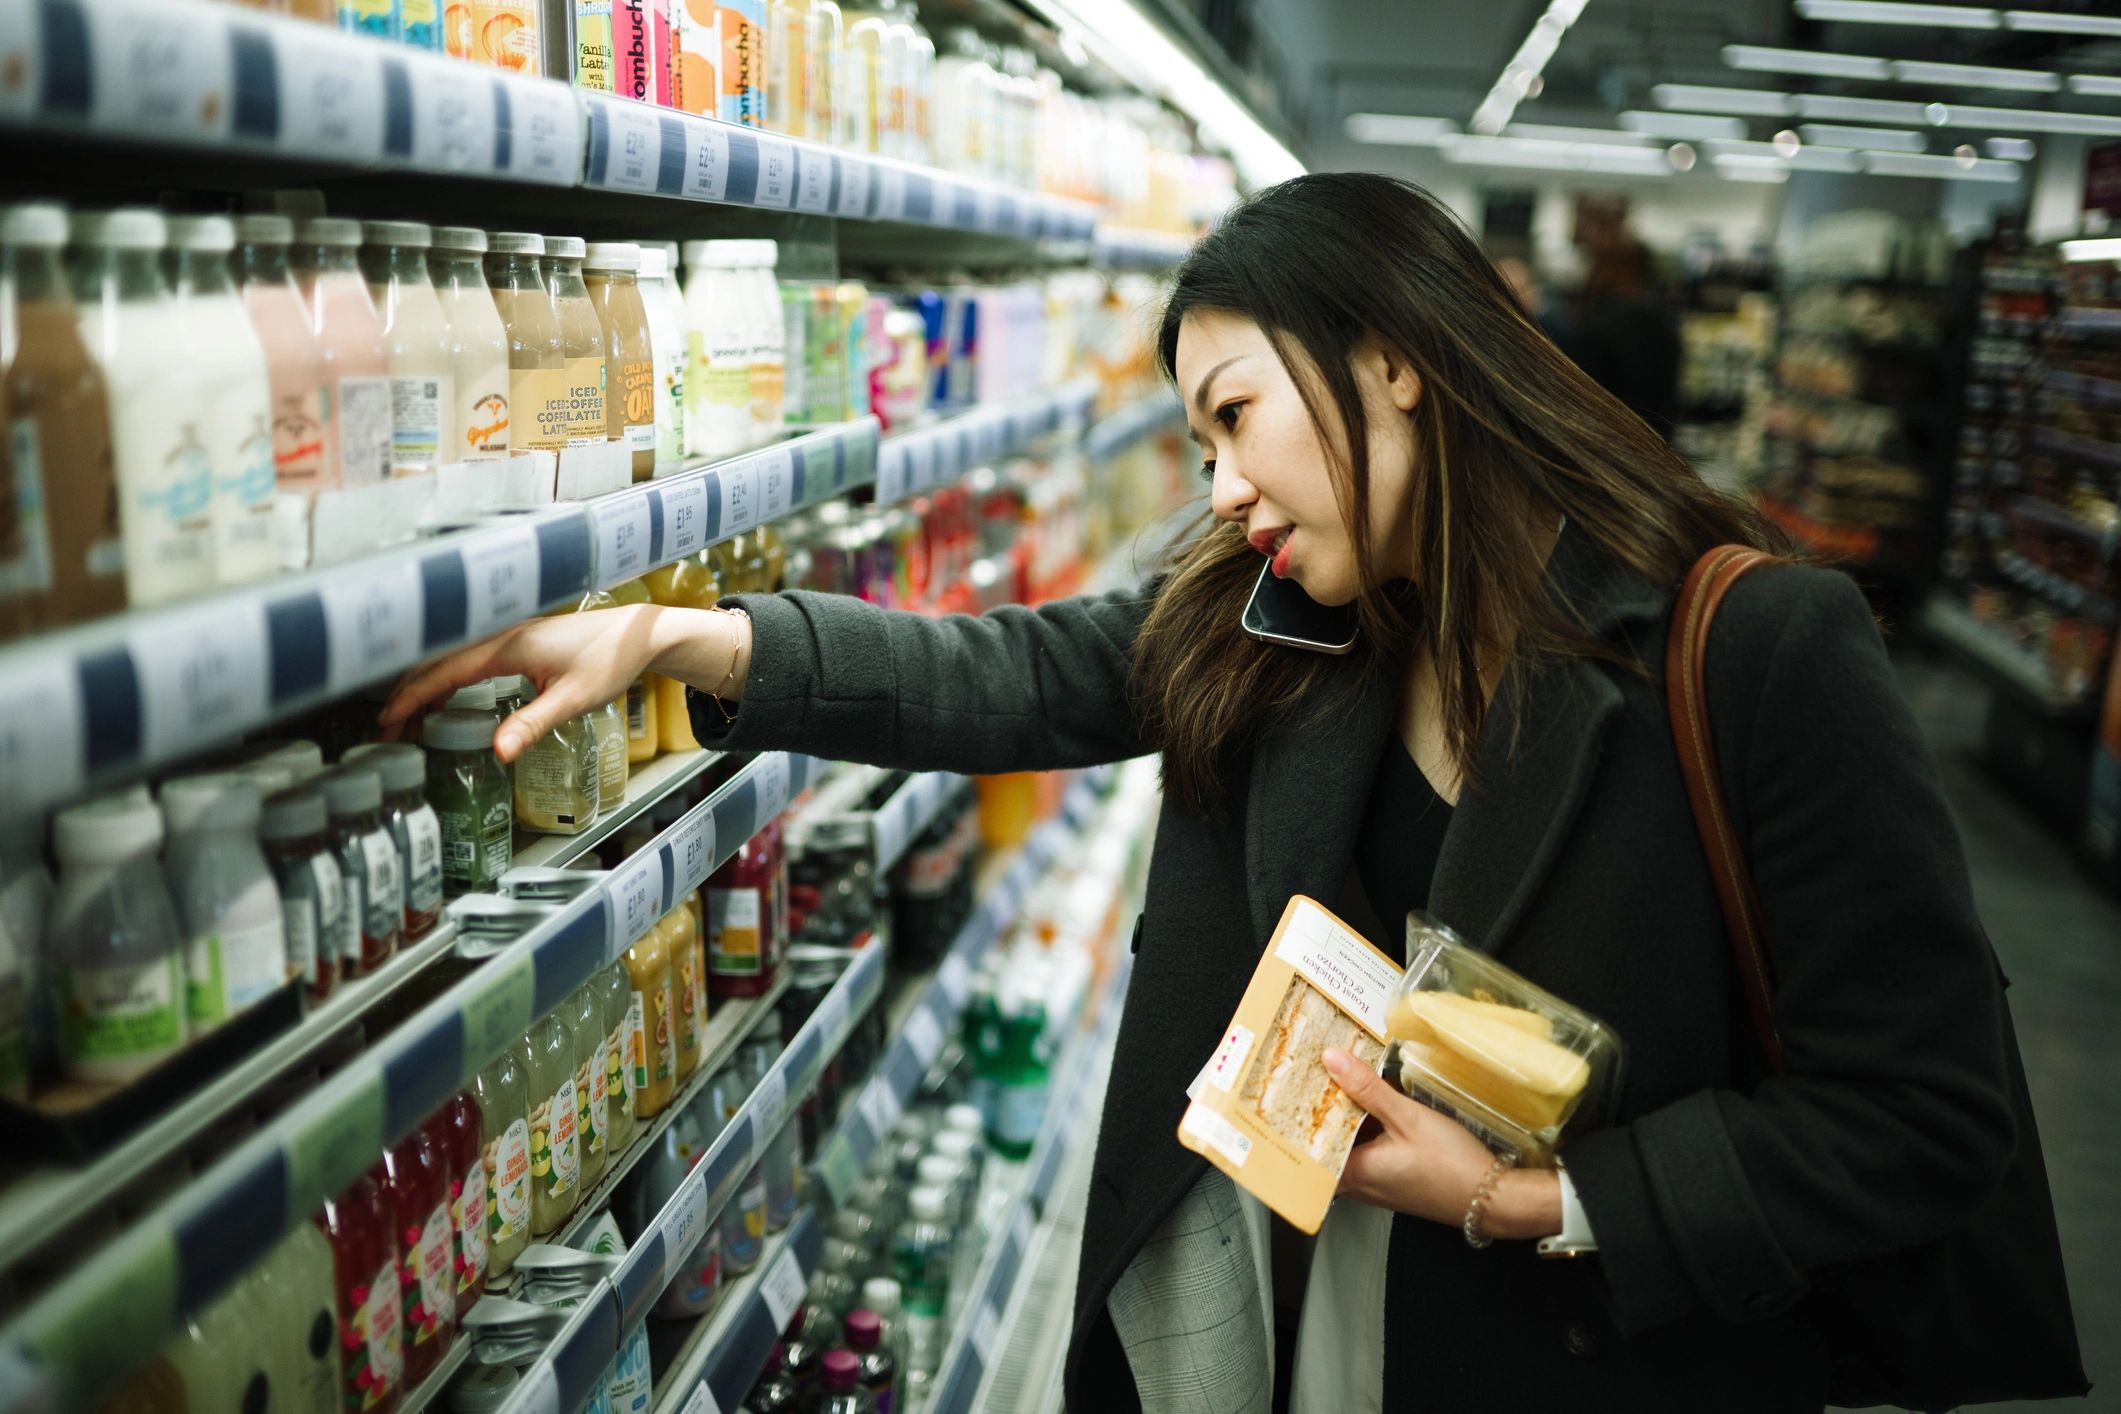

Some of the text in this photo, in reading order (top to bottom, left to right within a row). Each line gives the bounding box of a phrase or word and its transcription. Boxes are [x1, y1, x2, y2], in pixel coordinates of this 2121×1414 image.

[580, 57, 609, 71] Latte
[588, 73, 604, 81] with
[570, 386, 598, 398] ICED
[566, 397, 603, 410] OFFEE
[566, 410, 601, 422] LATTE
[676, 504, 693, 531] £1.95
[1317, 953, 1354, 988] Chorizo
[1339, 950, 1386, 990] BRITISH CHICKEN
[1303, 955, 1370, 1015] Roast Chicken
